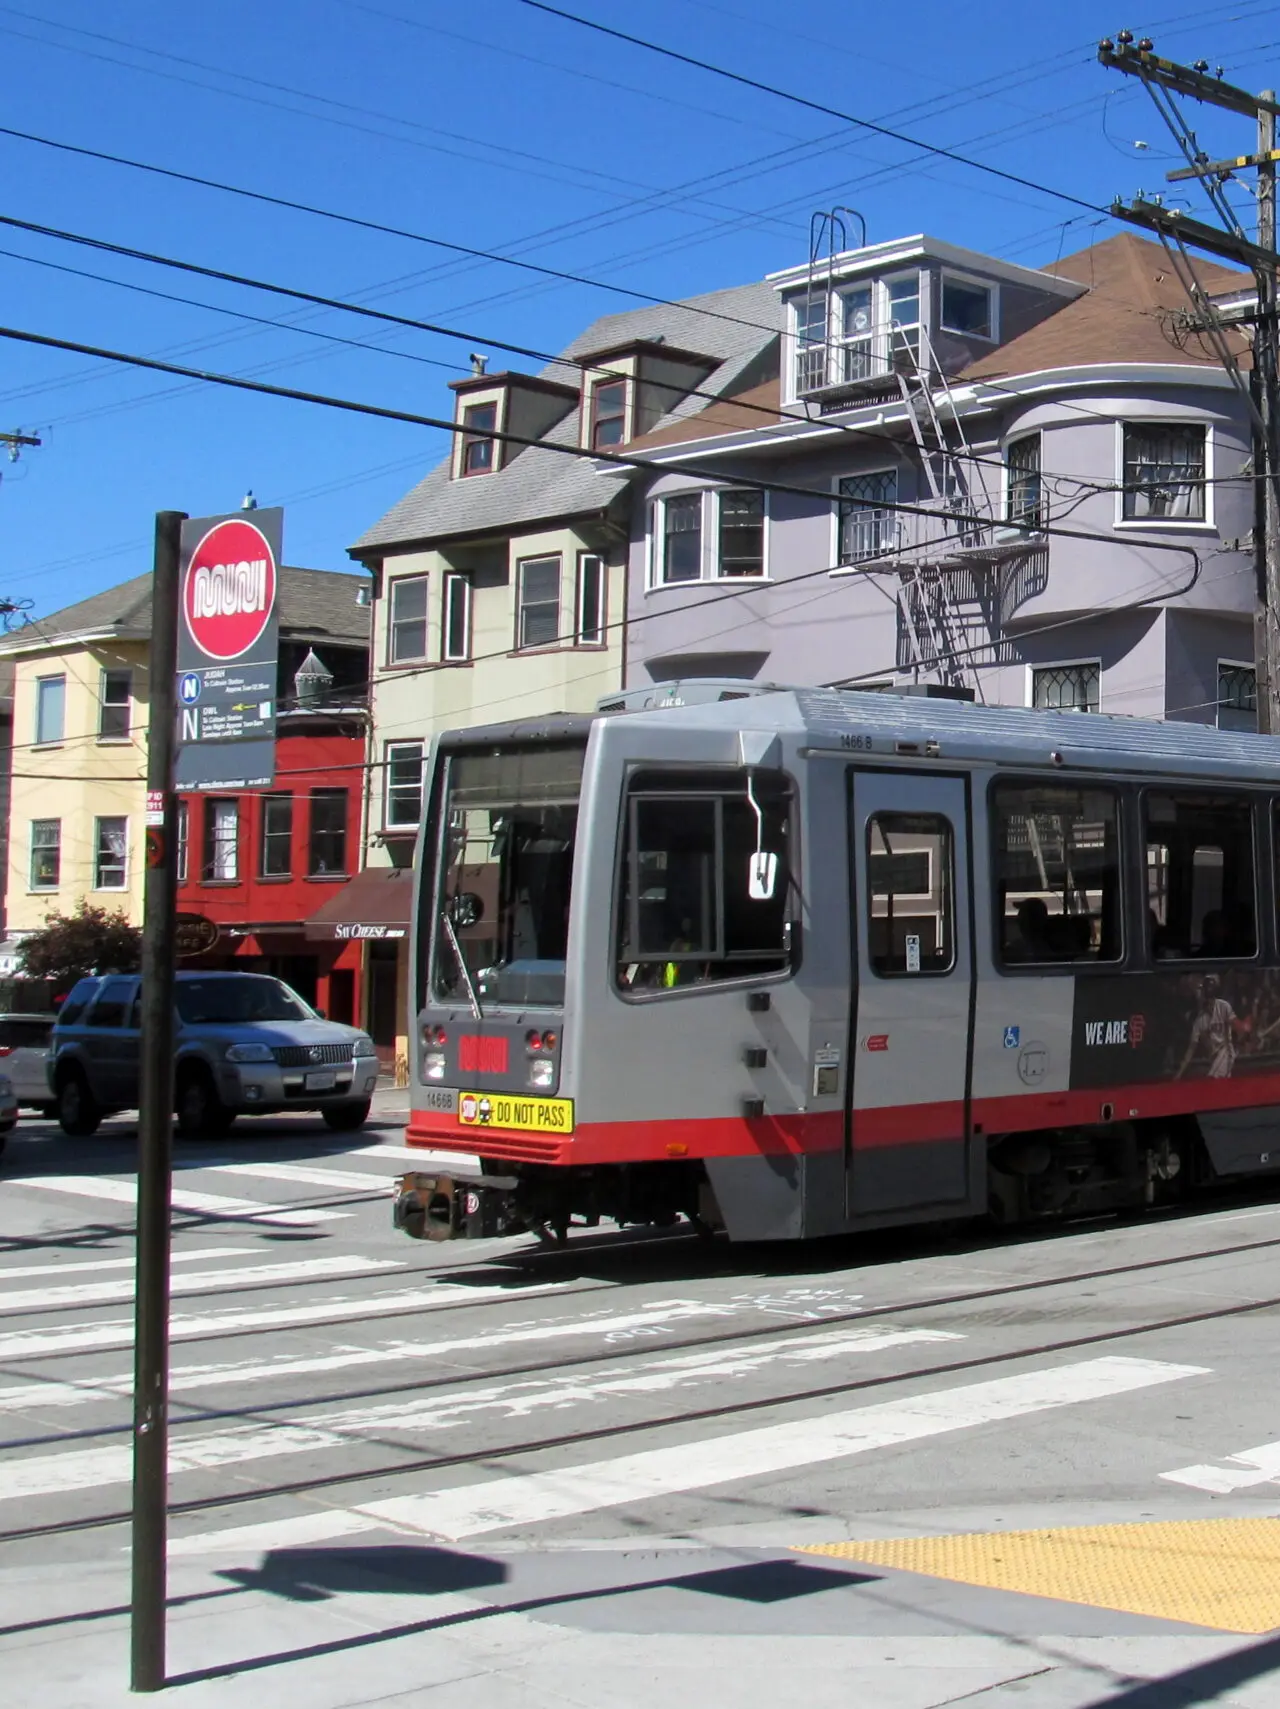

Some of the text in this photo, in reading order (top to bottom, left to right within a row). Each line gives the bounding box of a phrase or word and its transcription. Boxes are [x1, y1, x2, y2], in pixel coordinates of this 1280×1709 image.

[192, 559, 267, 619] MUNI
[184, 678, 197, 698] N
[182, 708, 198, 740] N
[1086, 1021, 1104, 1046] WE
[1104, 1020, 1129, 1045] ARE
[497, 1101, 565, 1127] DO NOT PASS
